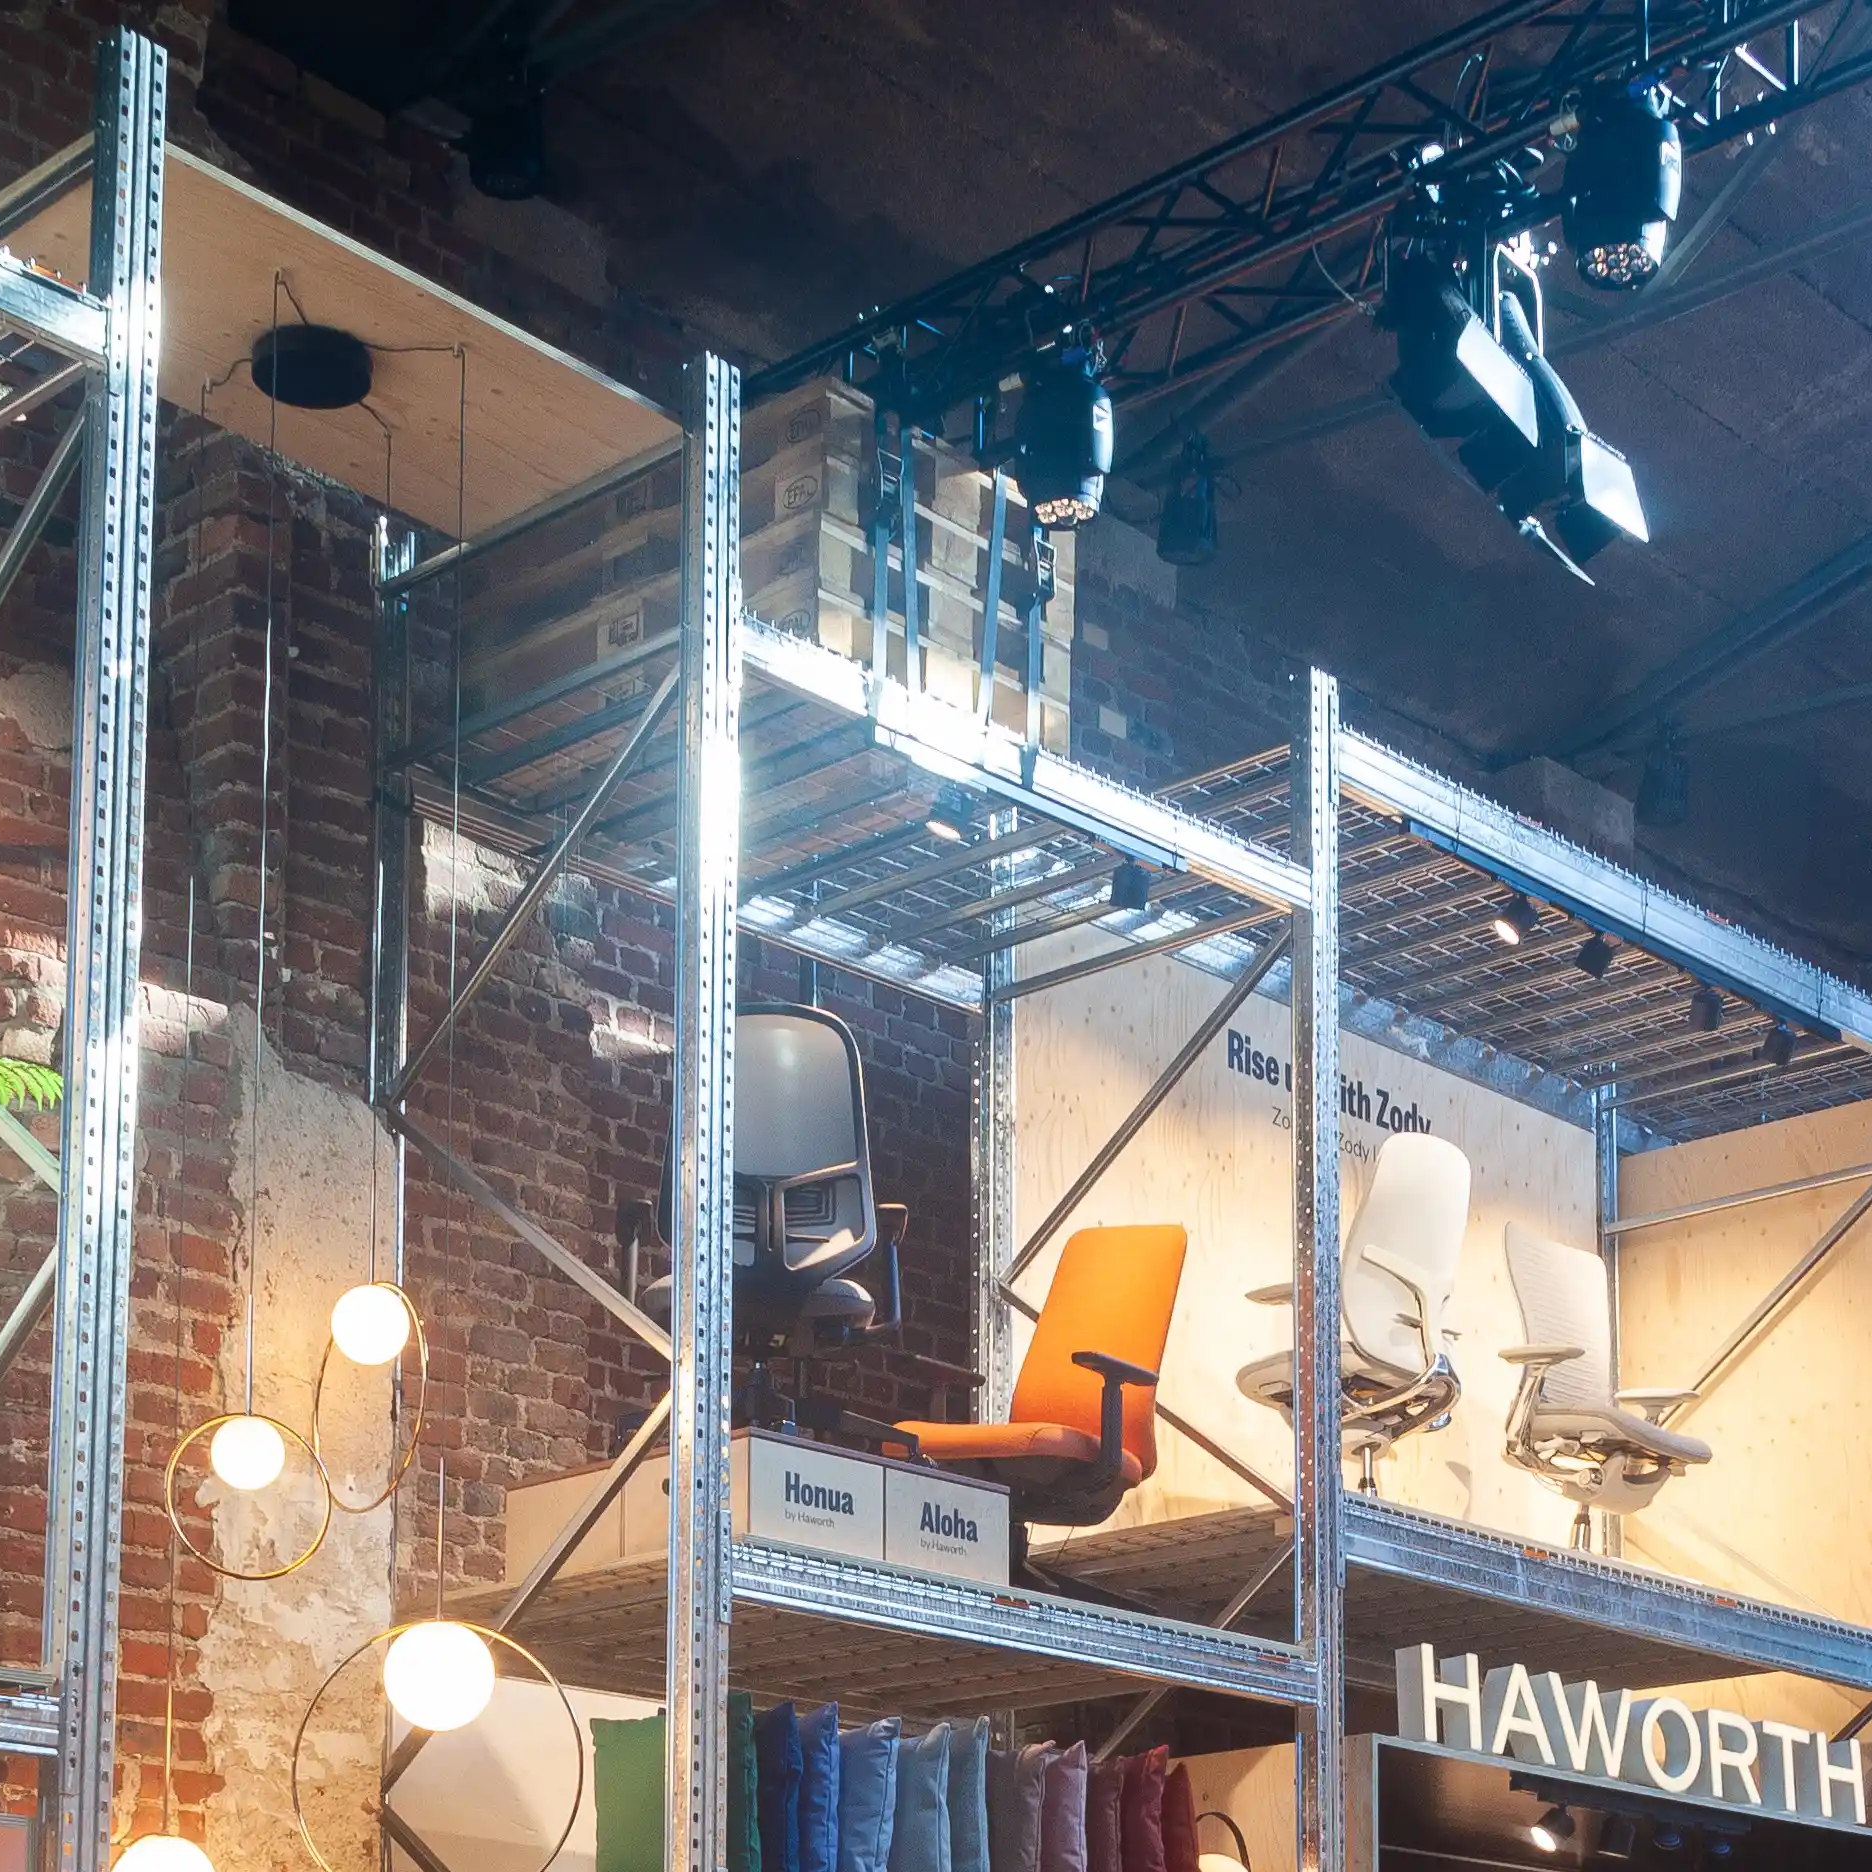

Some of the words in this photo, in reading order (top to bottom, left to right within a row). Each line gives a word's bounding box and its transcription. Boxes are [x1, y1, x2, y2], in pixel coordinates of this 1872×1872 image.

[1228, 1028, 1279, 1085] Rise
[1341, 1074, 1371, 1123] ith
[1377, 1088, 1431, 1134] Zody
[785, 1471, 854, 1515] Honua
[785, 1509, 797, 1523] by
[798, 1511, 835, 1529] Haworth
[920, 1501, 978, 1543] Aloha
[920, 1538, 931, 1551] by
[932, 1540, 967, 1556] Haworth
[1420, 1642, 1866, 1824] HAWORTH
